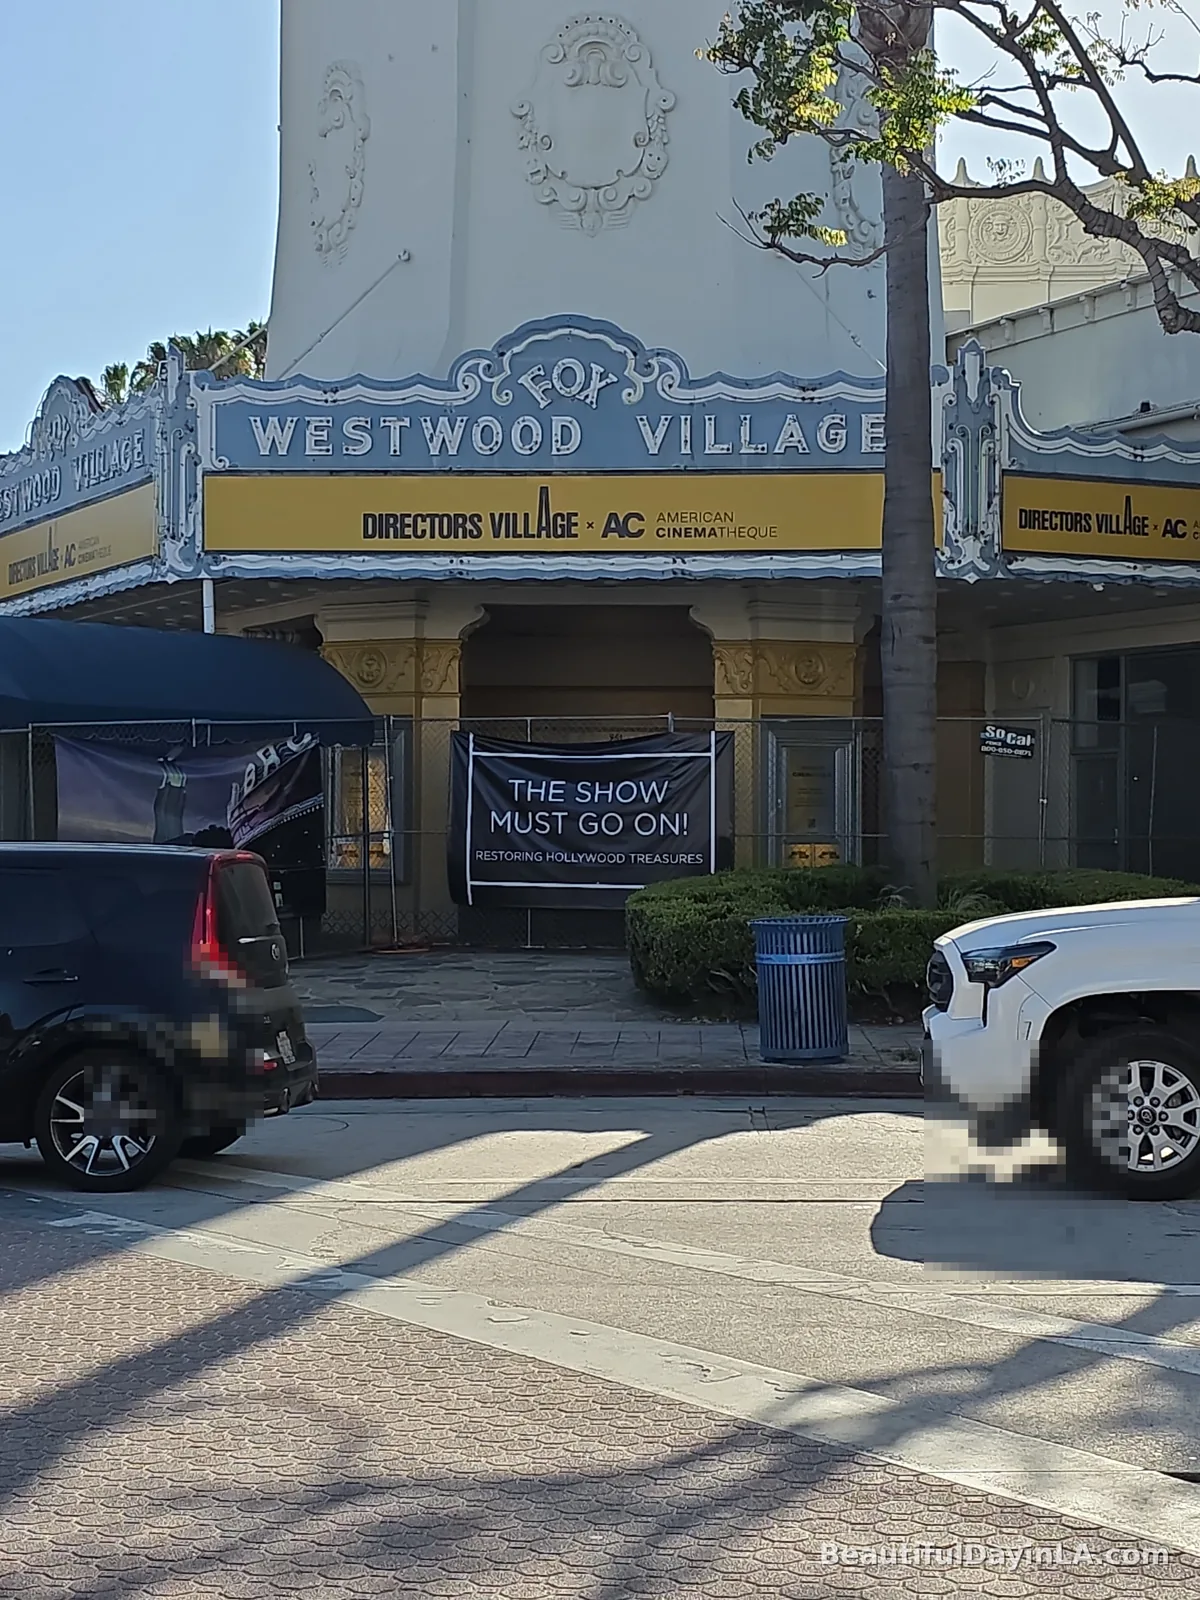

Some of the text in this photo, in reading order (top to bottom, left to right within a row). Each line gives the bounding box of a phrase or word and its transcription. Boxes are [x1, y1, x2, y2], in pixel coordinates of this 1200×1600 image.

[517, 357, 618, 411] FOX
[249, 413, 887, 456] WESTWOOD VILLAGE
[71, 428, 145, 492] VILLAGE
[362, 512, 483, 540] DIRECTORS
[489, 486, 579, 540] VILLAGE
[601, 512, 646, 539] AC
[656, 511, 734, 524] AMERICAN
[1018, 508, 1092, 533] DIRECTORS
[1095, 495, 1149, 537] VILLAGE
[1161, 518, 1187, 539] AC
[656, 526, 778, 540] CINEMATHEQUE
[508, 779, 669, 803] THE SHOW
[490, 811, 688, 836] MUST GO ON!
[475, 850, 704, 865] RESTORING HOLLYWOOD TREASURES
